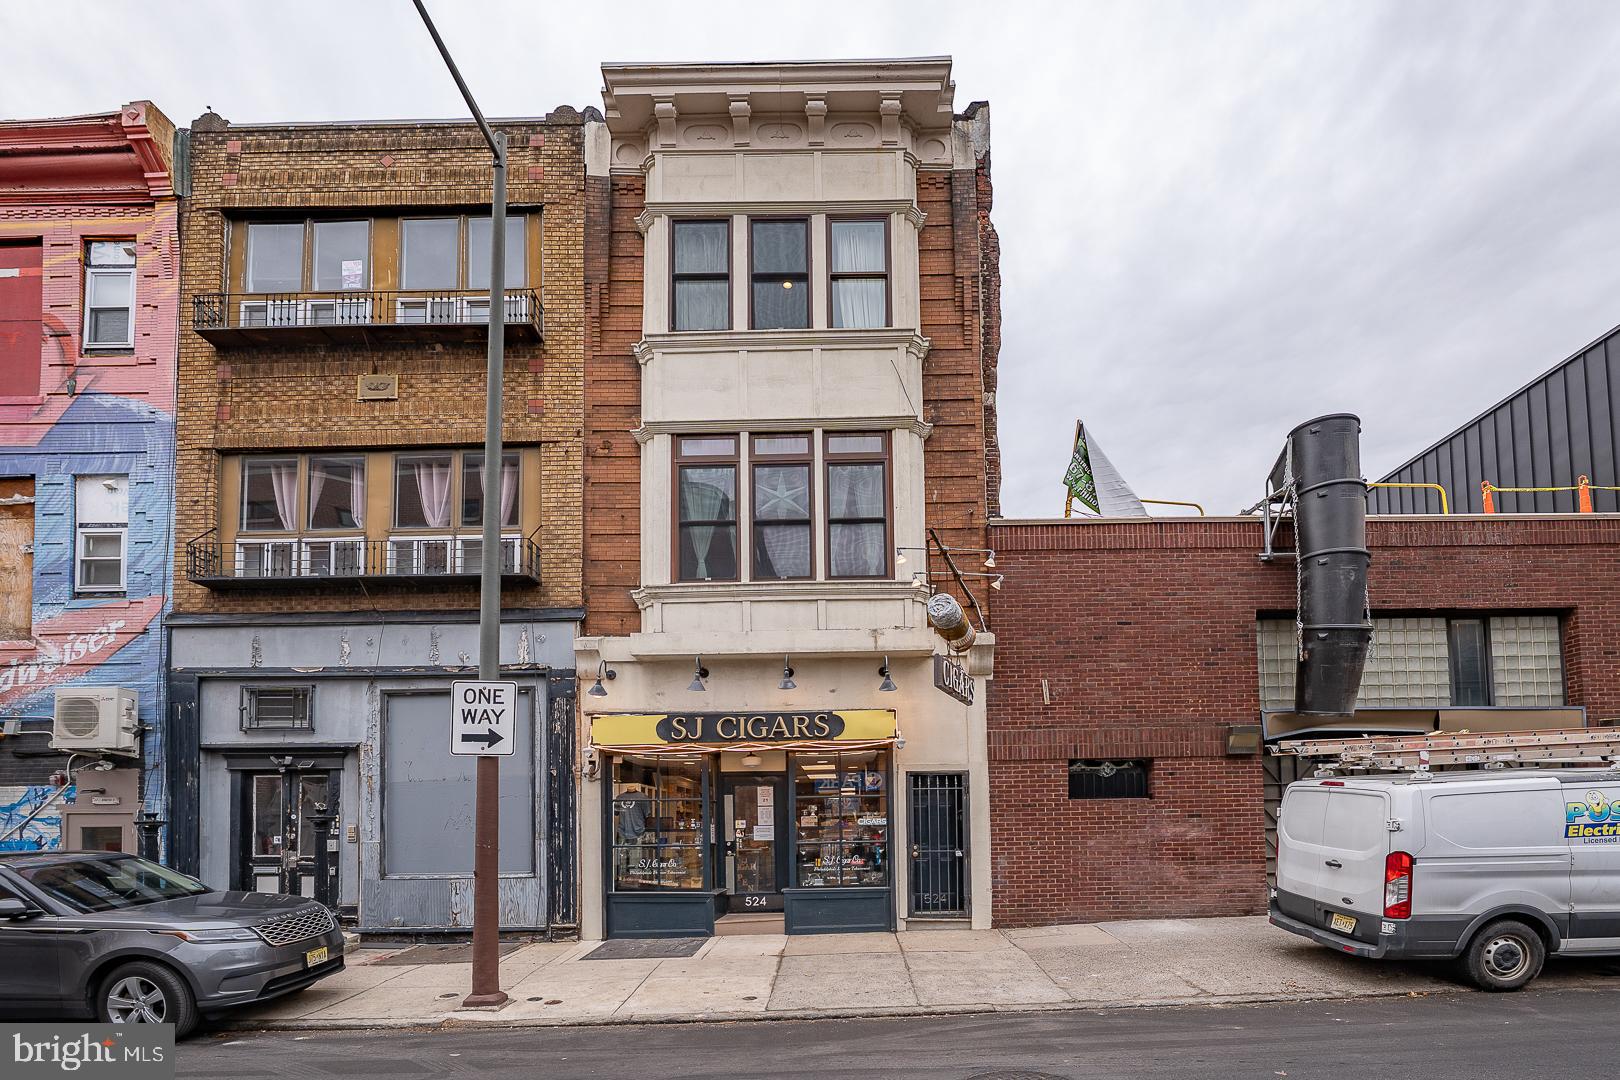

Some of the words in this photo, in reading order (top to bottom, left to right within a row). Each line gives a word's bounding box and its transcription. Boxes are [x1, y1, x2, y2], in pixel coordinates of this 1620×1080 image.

[943, 660, 975, 702] CIGARS
[463, 688, 505, 704] ONE
[461, 708, 506, 725] WAY
[670, 716, 703, 740] SJ
[716, 713, 829, 739] CIGARS
[745, 897, 767, 907] 524
[924, 893, 947, 904] 524
